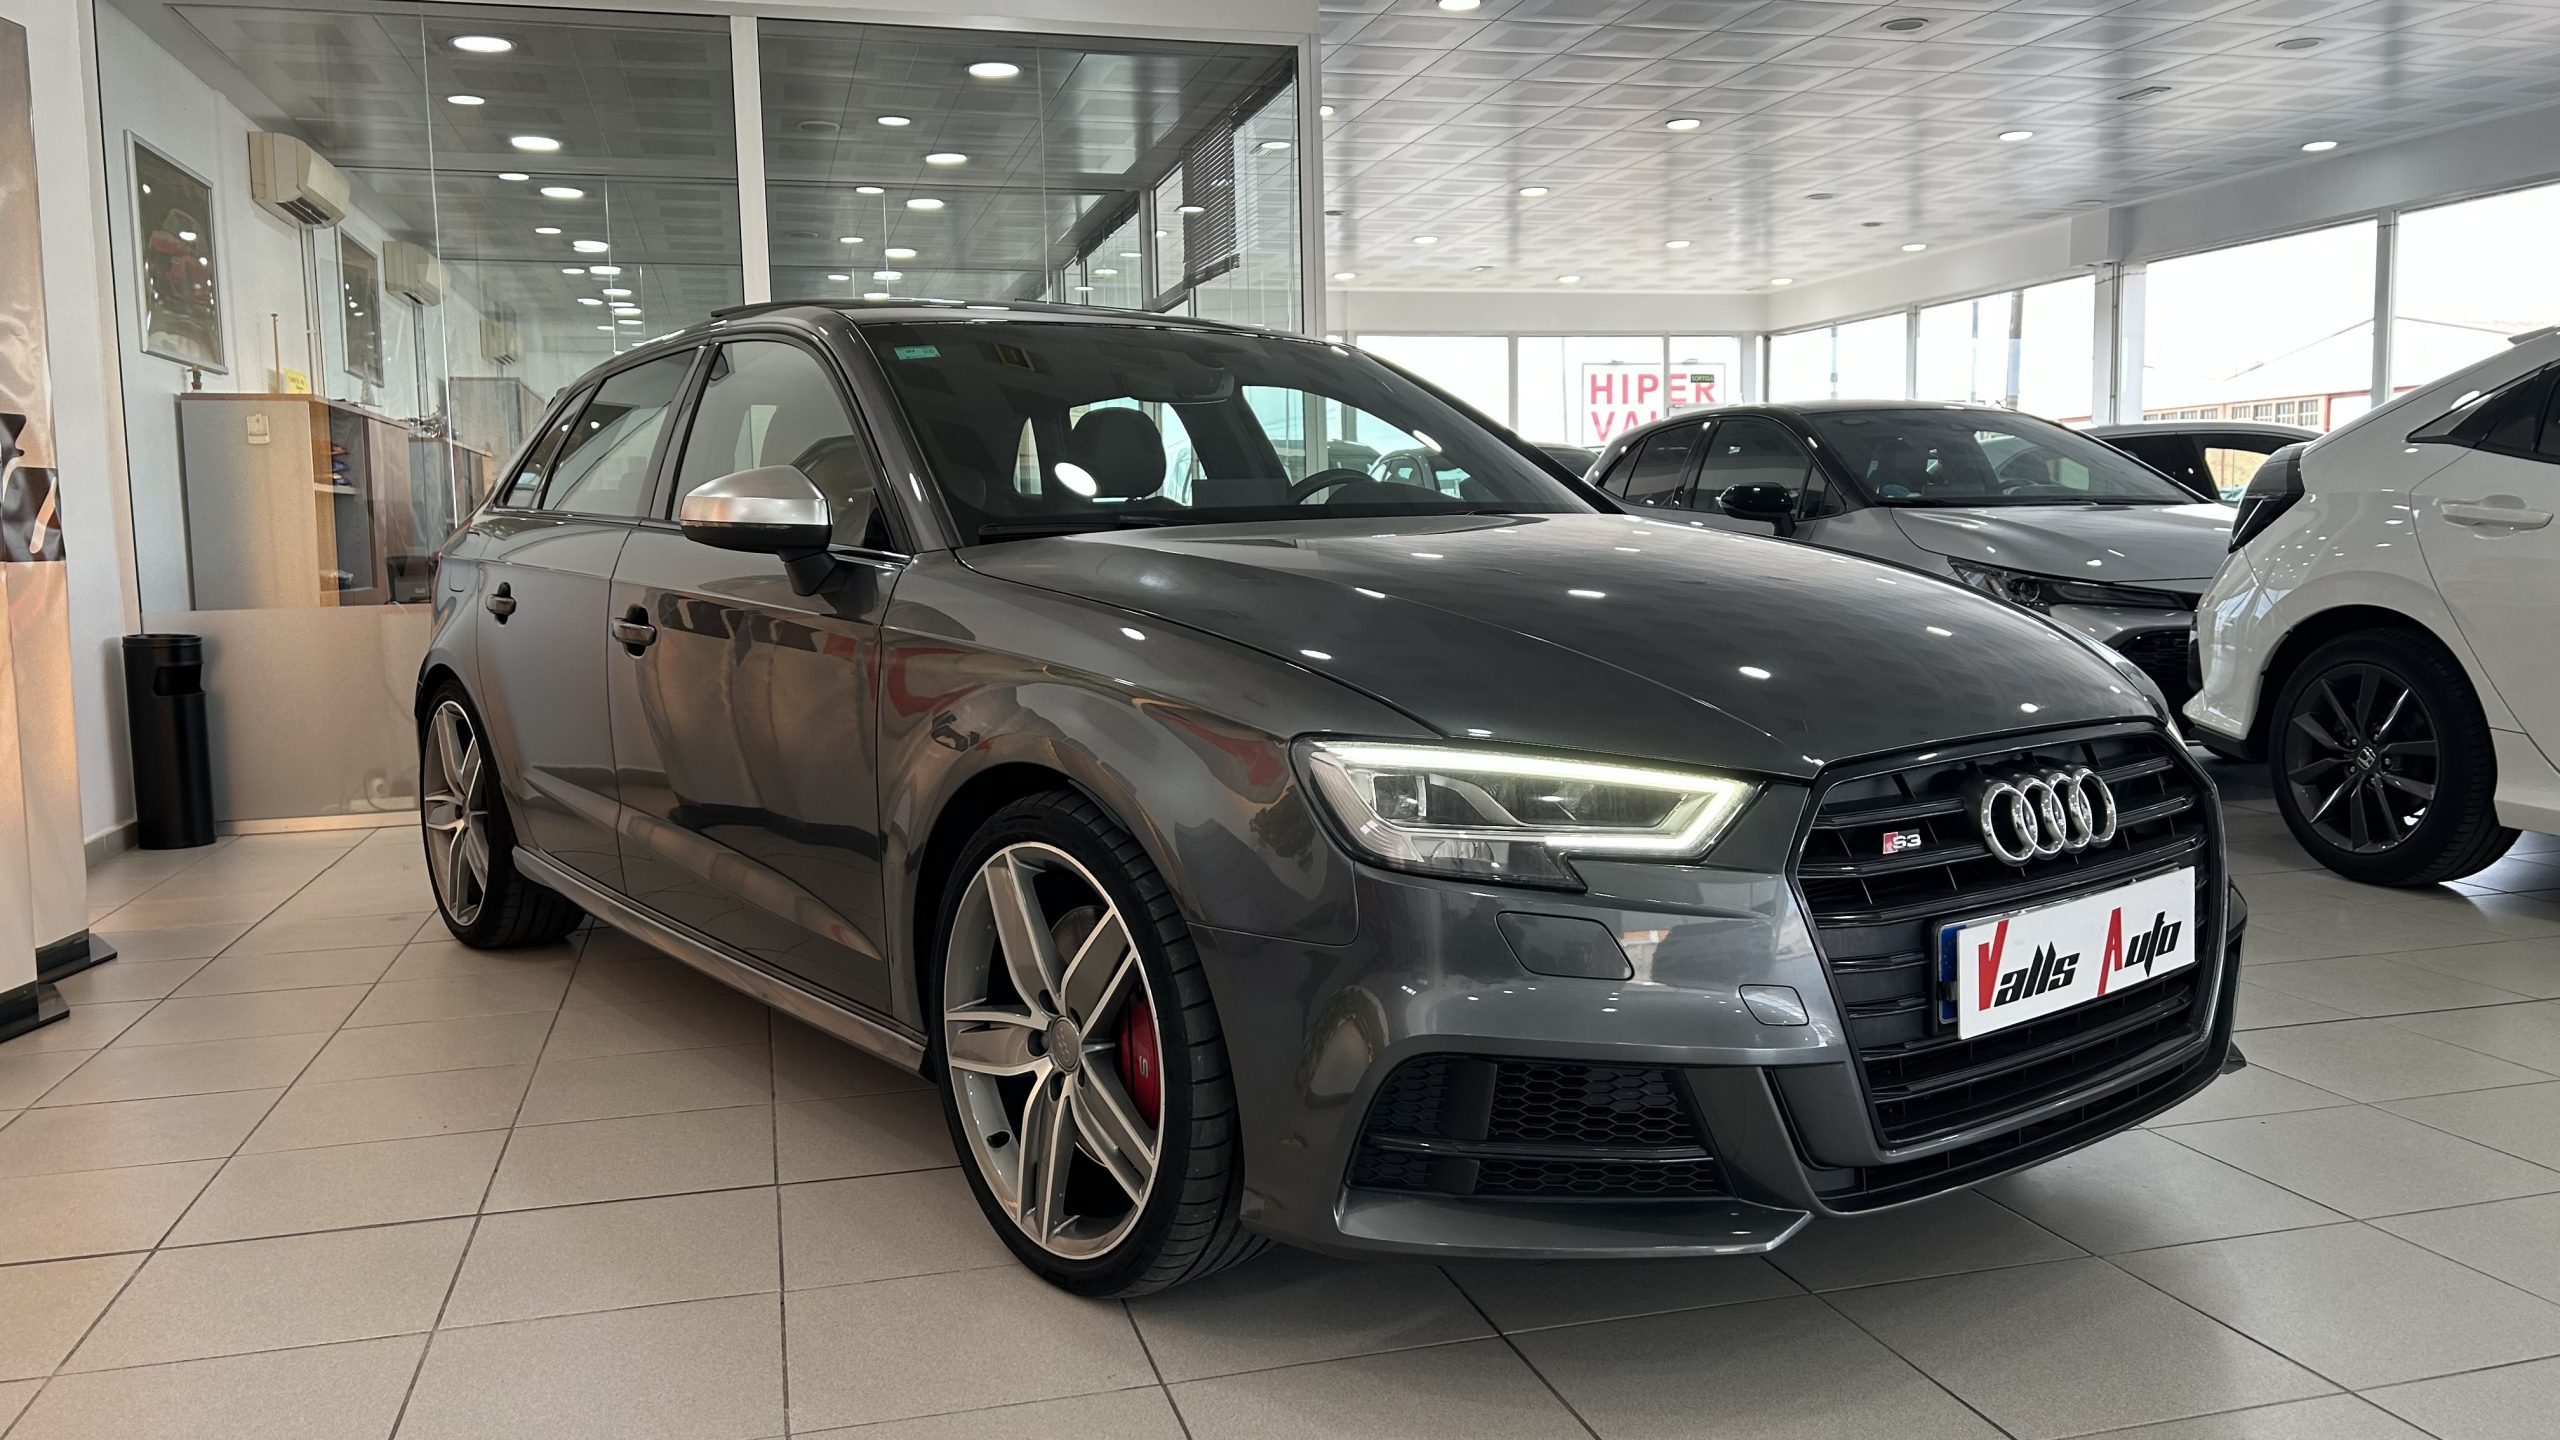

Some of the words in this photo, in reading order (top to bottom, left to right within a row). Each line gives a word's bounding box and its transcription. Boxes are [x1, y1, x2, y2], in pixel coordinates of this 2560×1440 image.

[1591, 373, 1716, 405] HIPER
[1892, 833, 1921, 849] S3
[1978, 918, 2080, 1012] Valls
[2097, 906, 2182, 997] Auto
